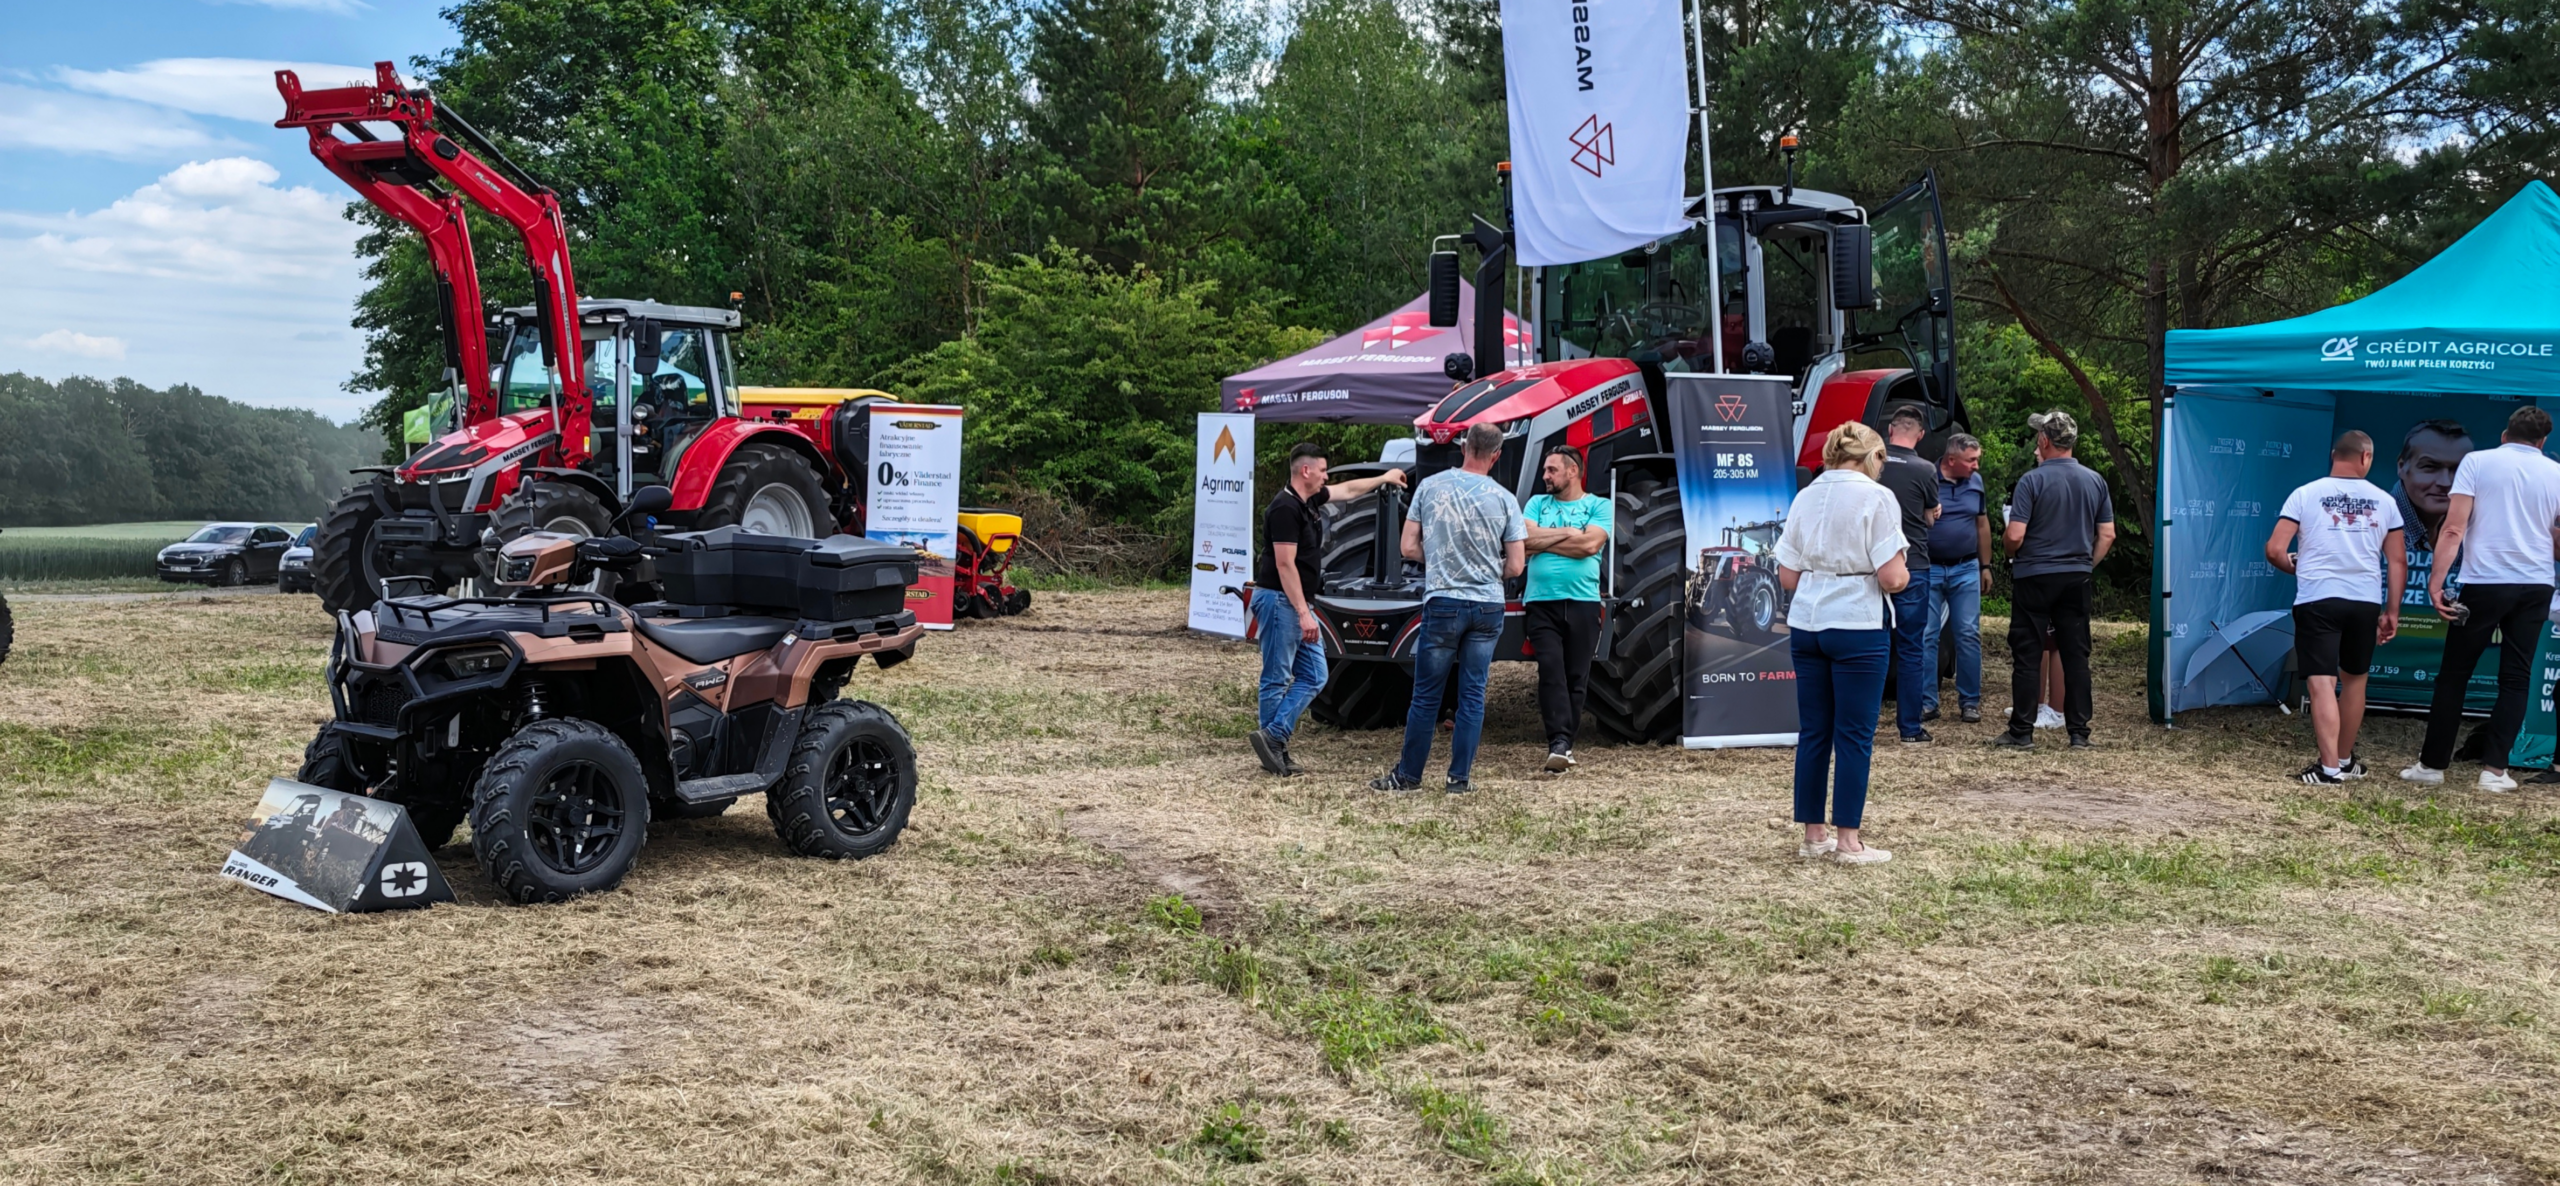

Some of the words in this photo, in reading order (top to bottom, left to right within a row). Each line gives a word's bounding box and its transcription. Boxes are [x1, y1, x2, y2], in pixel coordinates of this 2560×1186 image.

[2366, 339, 2440, 354] CRÉDIT
[2444, 341, 2553, 357] AGRICOLE
[1299, 356, 1353, 367] MASSEY
[1356, 354, 1436, 364] FERGUSON
[2365, 359, 2389, 369] TWÓJ
[2391, 359, 2417, 368] BANK
[2418, 359, 2447, 368] PEŁEN
[2449, 358, 2495, 370] KORZYŚCI
[1261, 392, 1299, 404] MASSEY
[1301, 389, 1349, 402] FERGUSON
[1567, 393, 1600, 420] MASSEY
[1600, 379, 1631, 403] FERGUSON
[880, 434, 915, 442] Atrakcyjne
[879, 442, 923, 450] finansowanie
[502, 445, 530, 463] MASSEY
[1716, 453, 1735, 467] MF
[1738, 453, 1754, 467] 8S
[1713, 469, 1745, 479] 205-305
[1746, 469, 1759, 479] KM
[1201, 475, 1245, 495] Agrimar
[2322, 501, 2377, 511] NAUTICAL
[1222, 547, 1247, 556] POLARIS
[905, 590, 927, 598] RSTAD
[2384, 666, 2400, 674] 159
[695, 675, 726, 689] AWD
[1702, 673, 1736, 683] BORN
[1739, 672, 1755, 682] TO
[1759, 671, 1797, 681] FARM
[223, 865, 279, 888] RANGER
